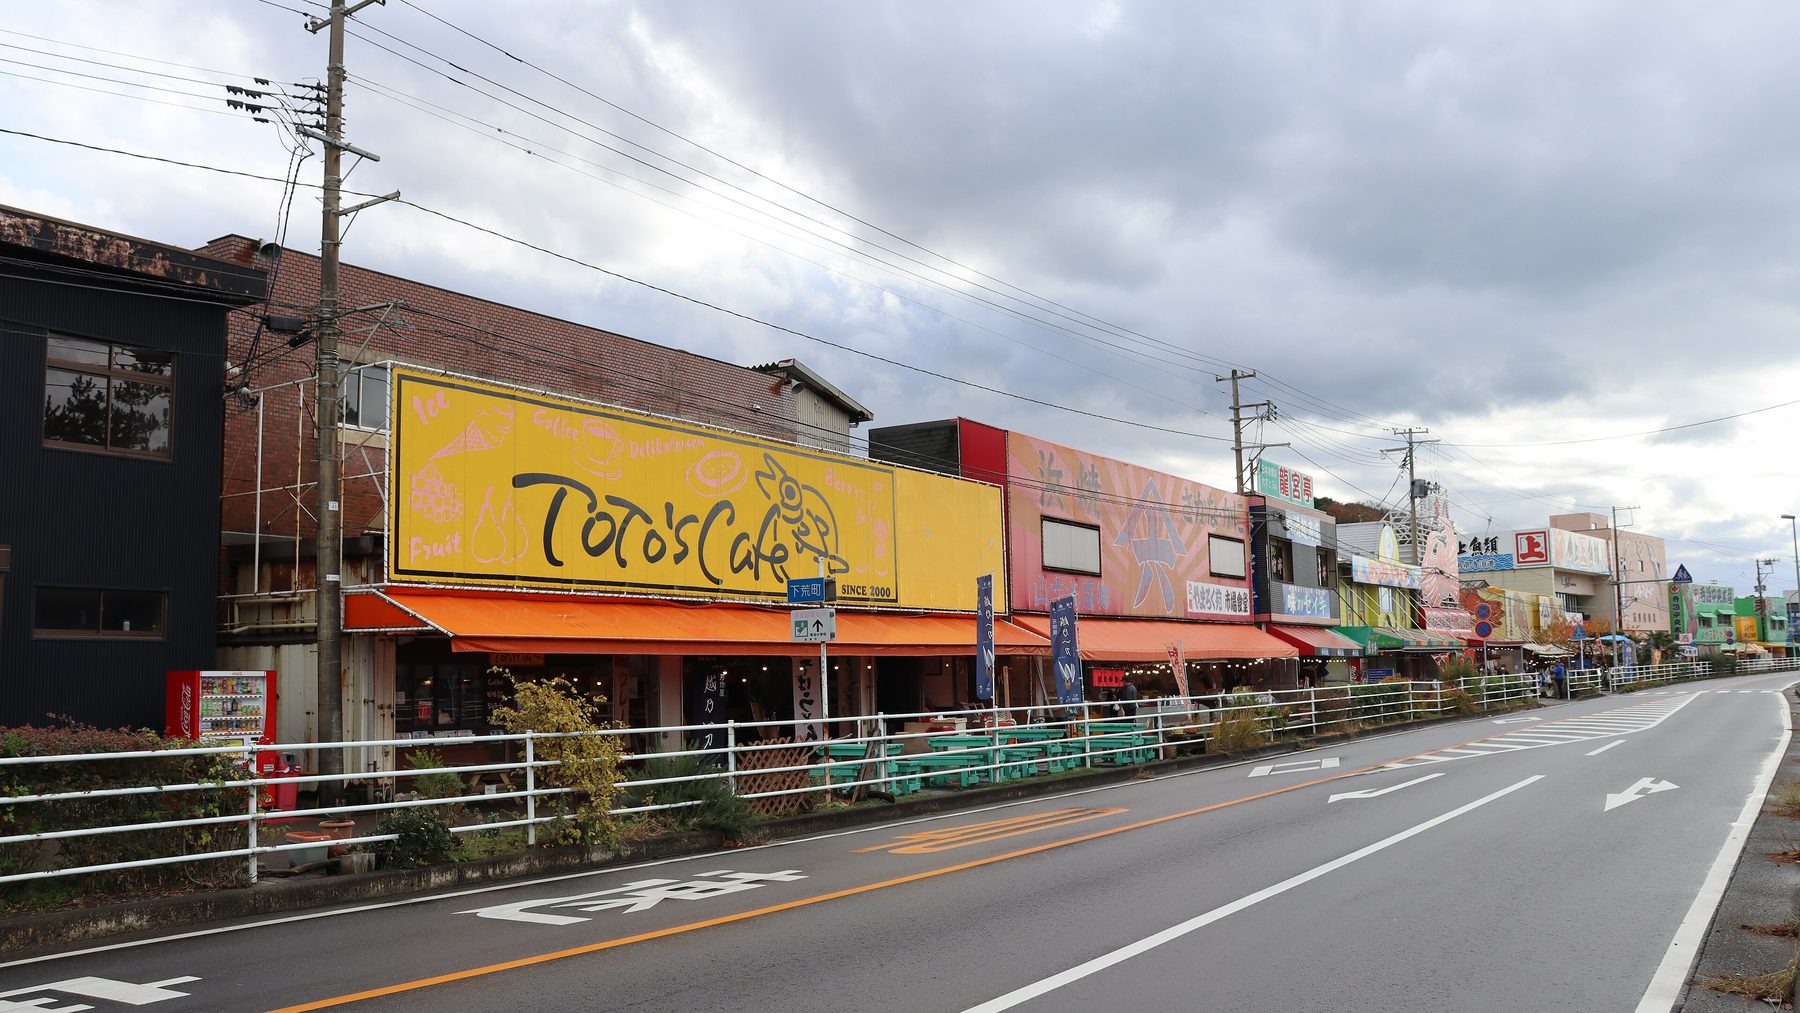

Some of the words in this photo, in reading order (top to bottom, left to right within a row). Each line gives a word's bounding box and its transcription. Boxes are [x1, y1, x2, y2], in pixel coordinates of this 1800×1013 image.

[412, 390, 450, 425] Ice
[532, 408, 579, 441] Coffee
[410, 531, 462, 566] Fruit
[1519, 535, 1545, 561] 上
[789, 583, 822, 598] 下荒町
[841, 584, 867, 596] SINCE
[870, 585, 891, 598] 2000
